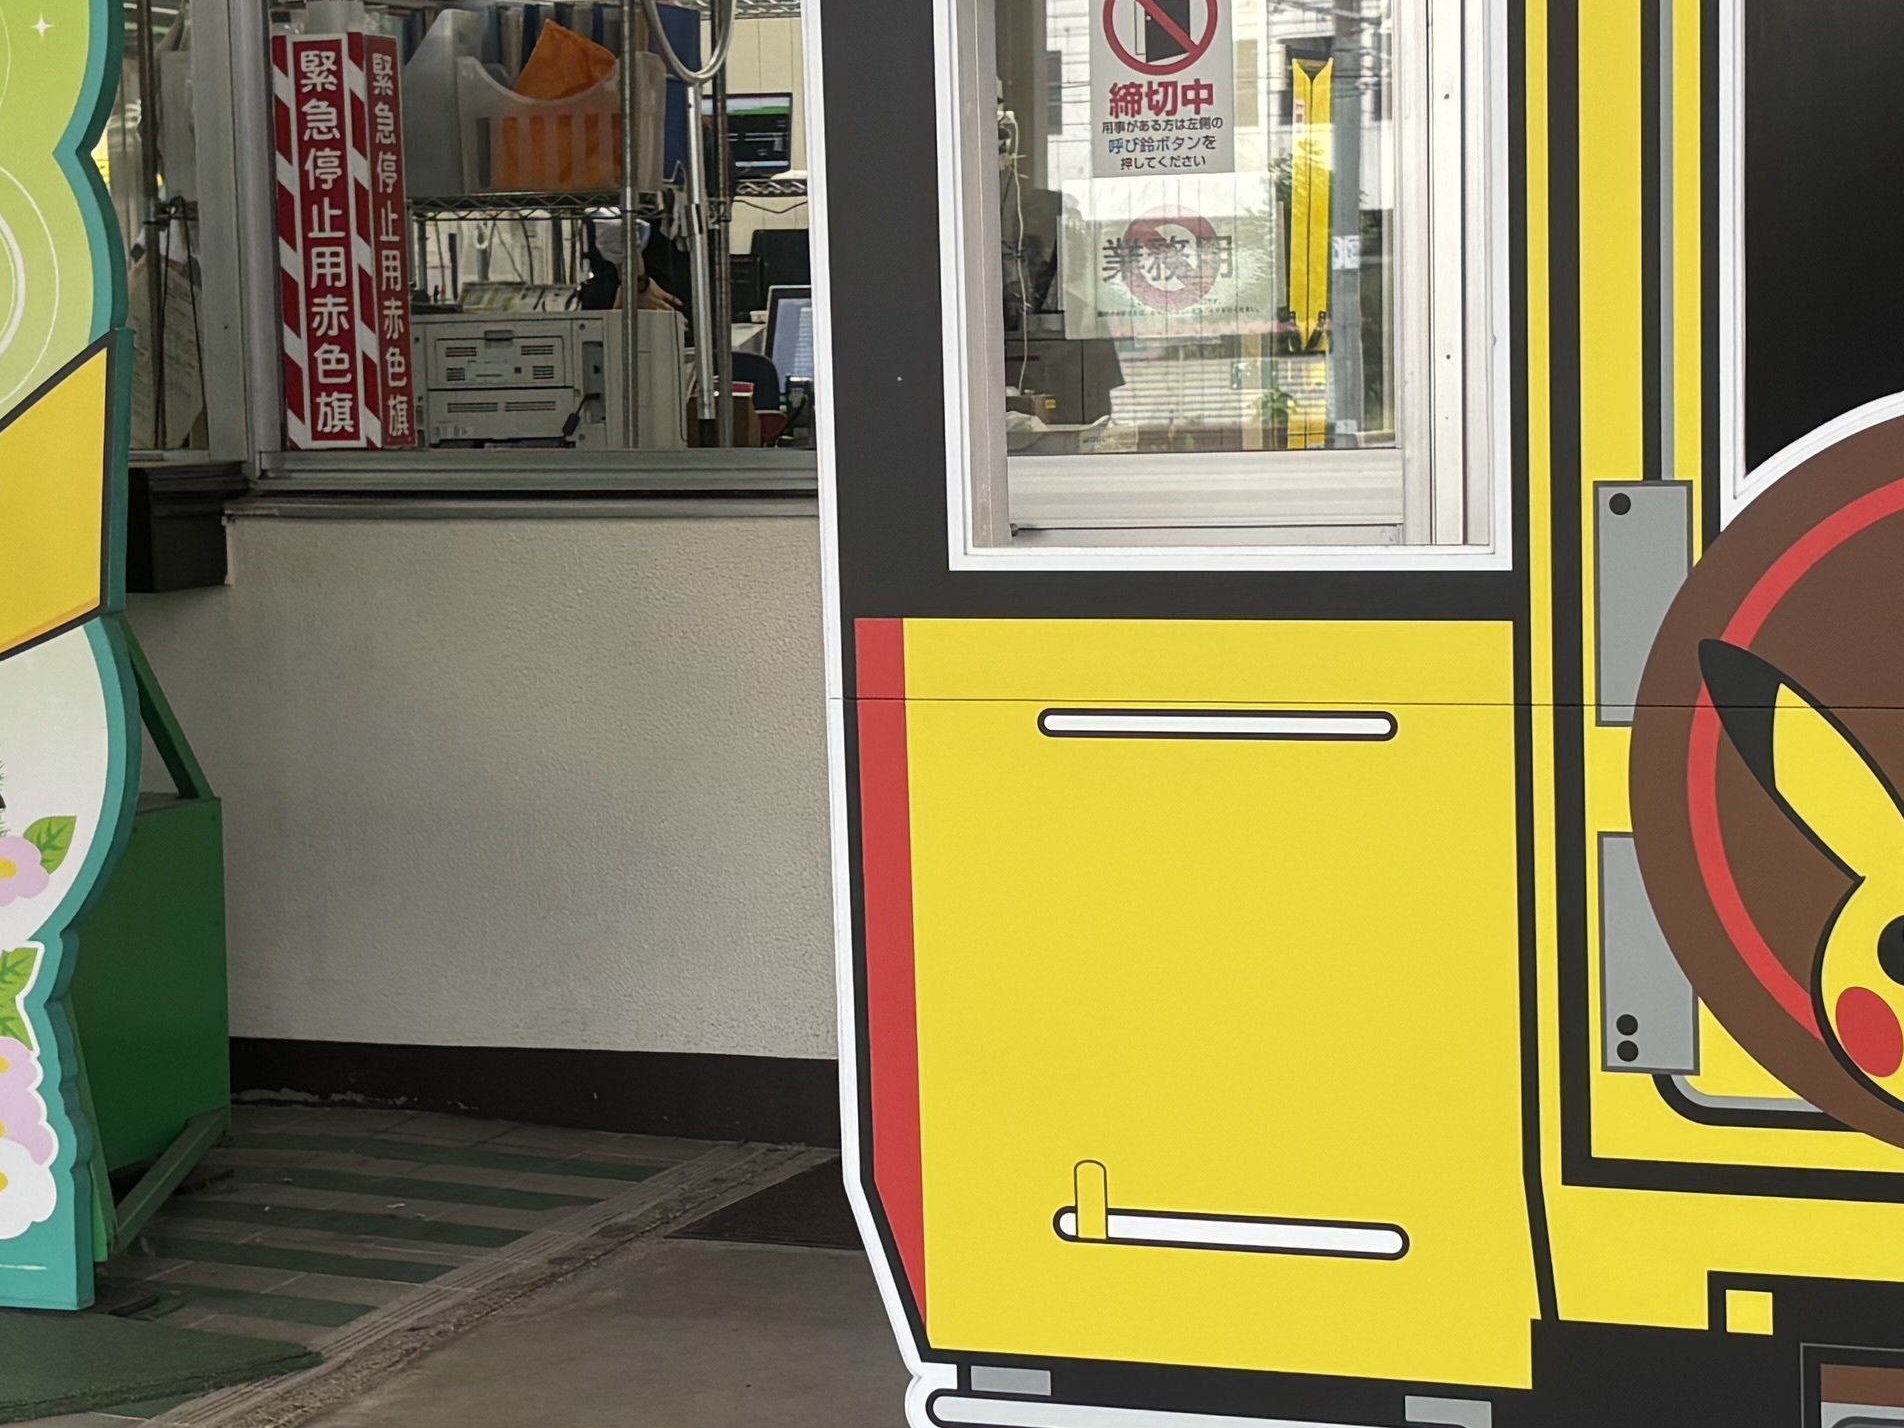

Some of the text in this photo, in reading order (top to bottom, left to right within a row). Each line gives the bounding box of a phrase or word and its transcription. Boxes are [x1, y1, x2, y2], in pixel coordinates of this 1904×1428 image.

[1108, 78, 1214, 119] 締切中
[299, 49, 355, 436] 緊急停止用赤色旗
